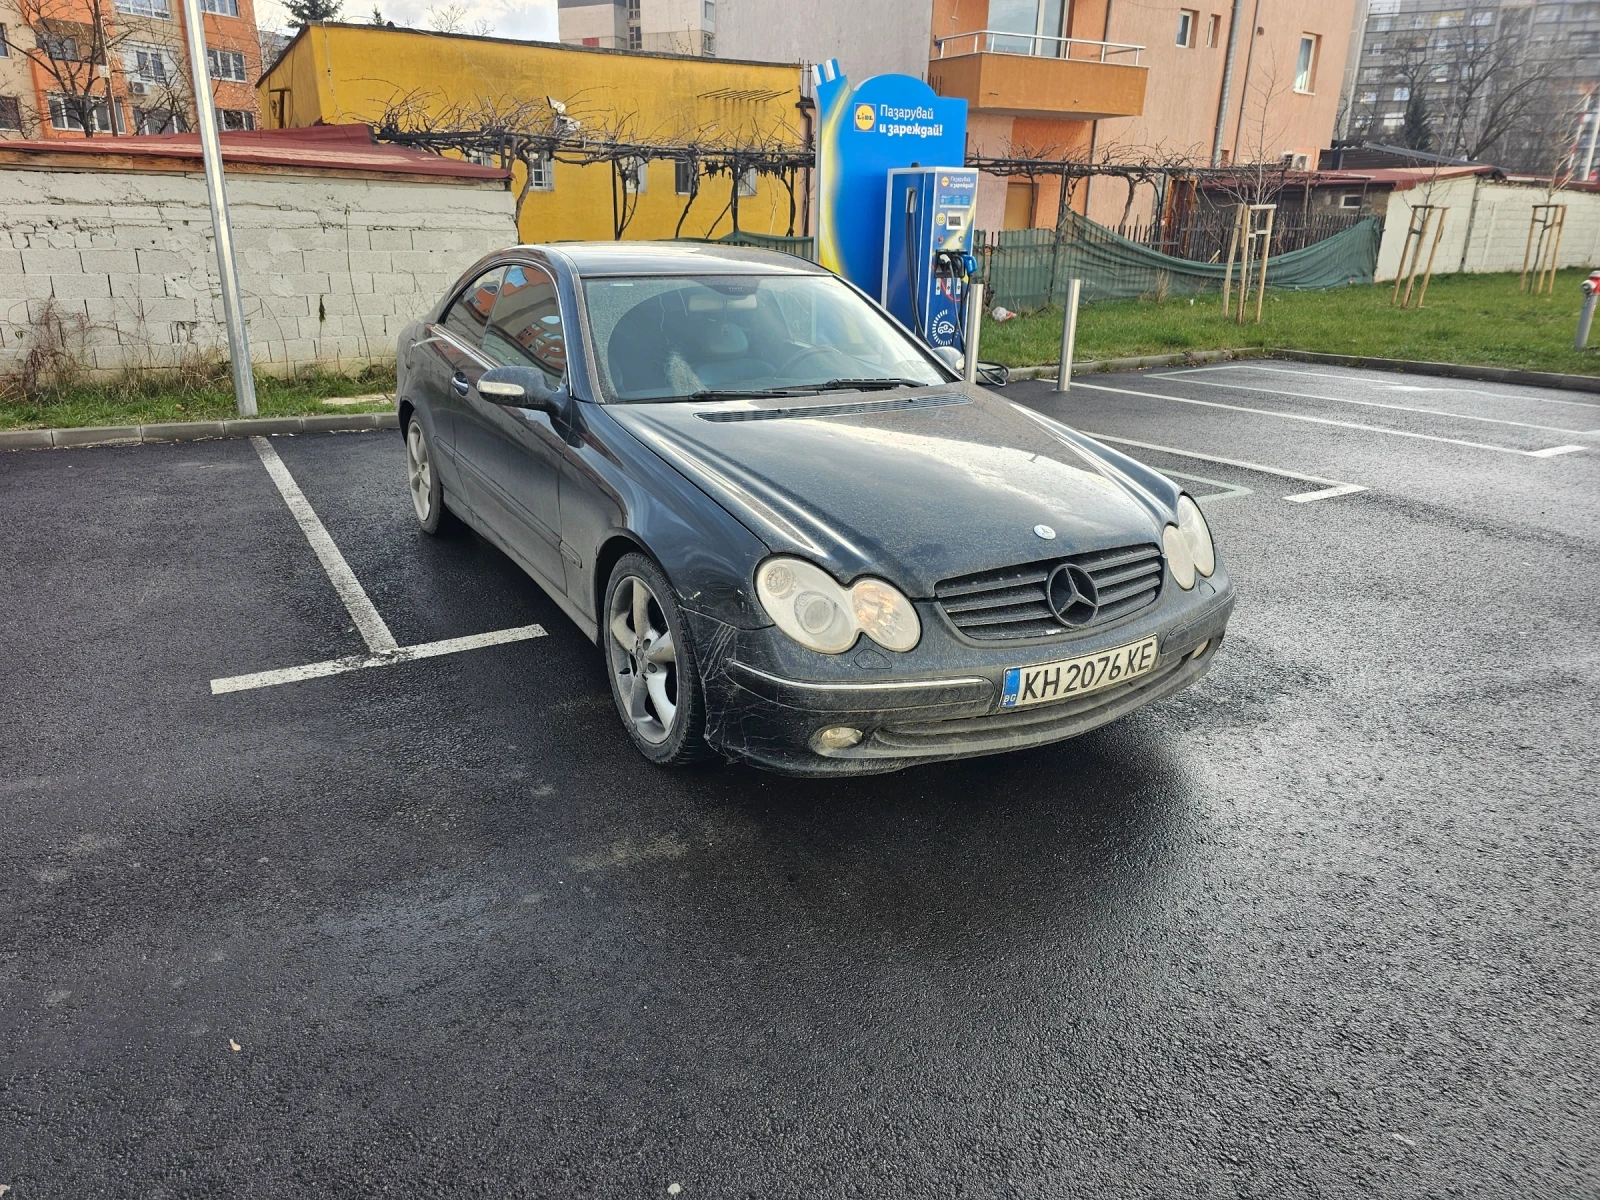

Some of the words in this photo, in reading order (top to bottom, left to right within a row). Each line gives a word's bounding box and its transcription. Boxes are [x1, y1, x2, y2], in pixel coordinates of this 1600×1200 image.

[880, 104, 934, 121] Пазарувай
[879, 123, 886, 133] и
[887, 122, 943, 138] зареждай!
[1004, 694, 1017, 702] BG
